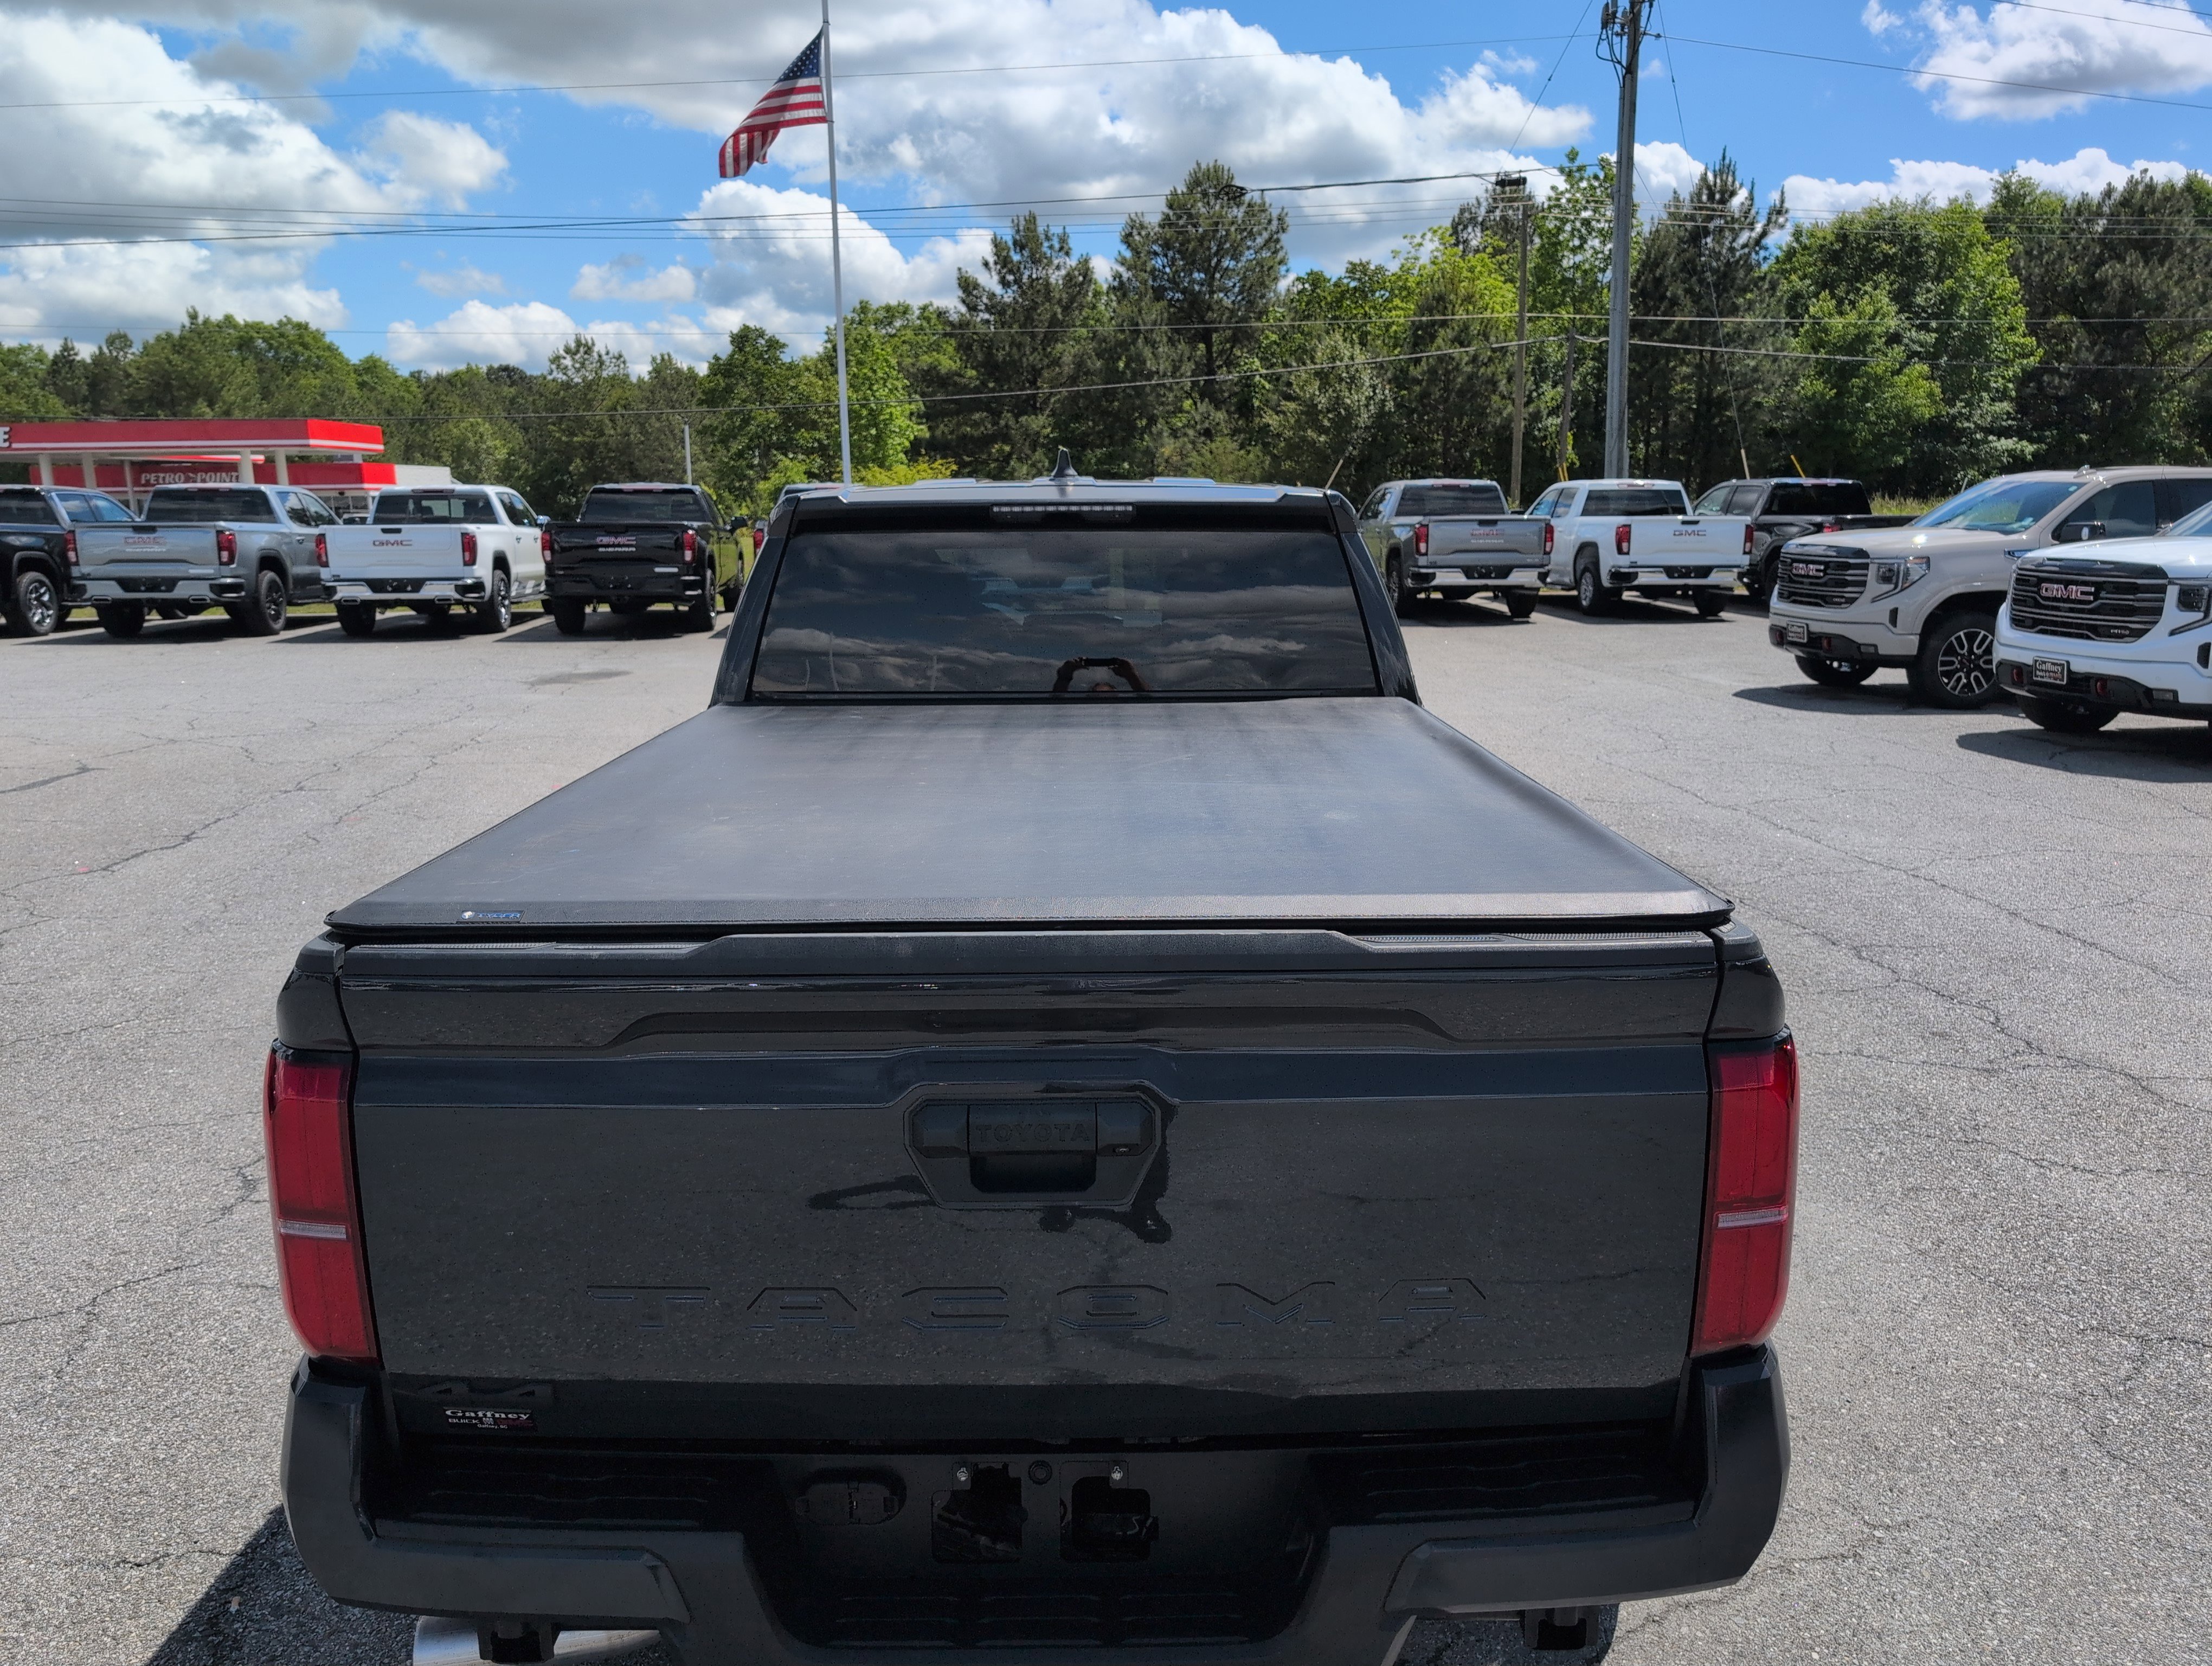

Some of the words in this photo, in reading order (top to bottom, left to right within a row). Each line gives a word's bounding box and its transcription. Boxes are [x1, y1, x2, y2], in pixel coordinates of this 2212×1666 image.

[140, 472, 185, 484] PETRO
[197, 471, 240, 483] POINT
[372, 539, 413, 547] GMC
[596, 536, 637, 545] GMC
[1792, 563, 1824, 576] GMC
[2040, 583, 2095, 601] GMC
[2036, 659, 2062, 674] Gaffney
[975, 1123, 1090, 1142] TOYOTA
[586, 1277, 1488, 1330] TACOMA
[445, 1409, 530, 1420] Gaffney
